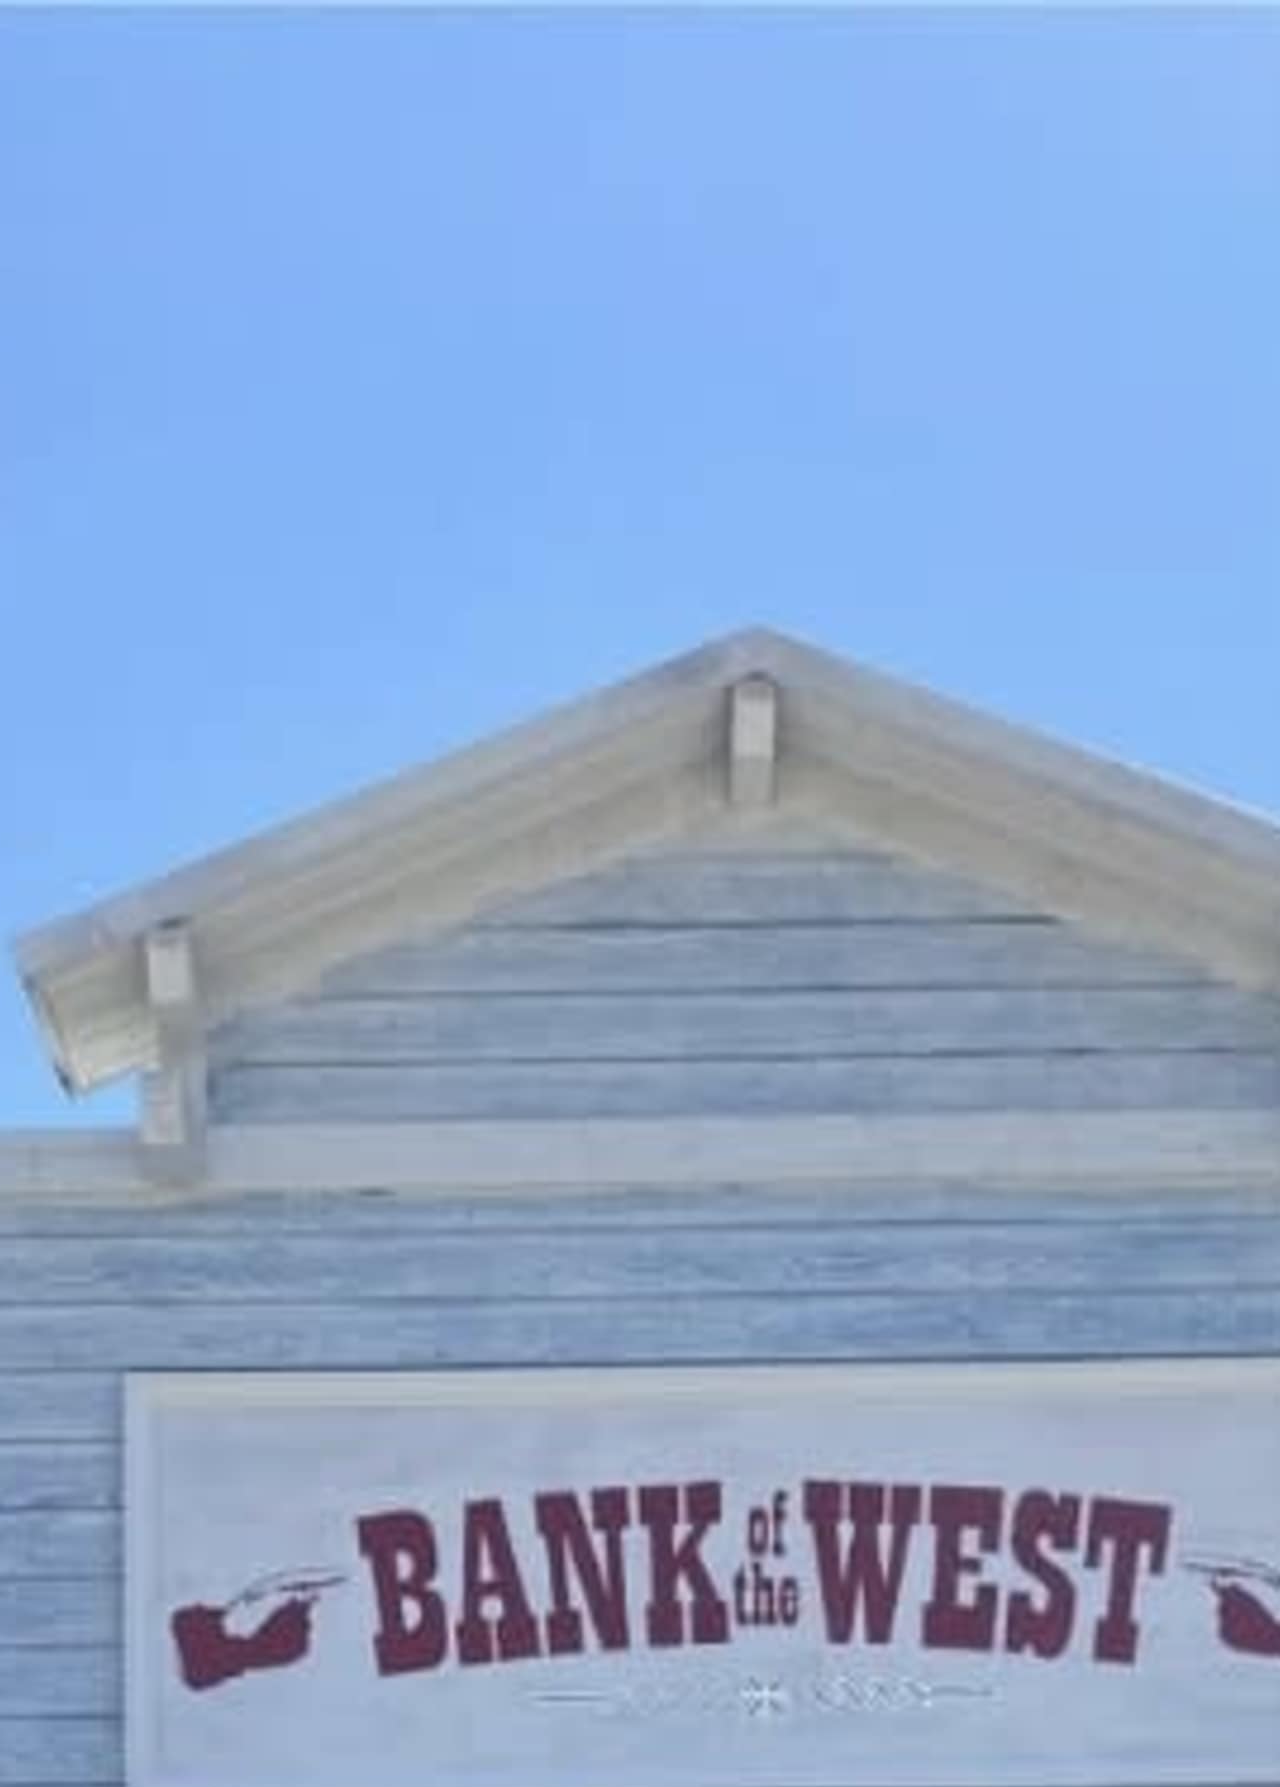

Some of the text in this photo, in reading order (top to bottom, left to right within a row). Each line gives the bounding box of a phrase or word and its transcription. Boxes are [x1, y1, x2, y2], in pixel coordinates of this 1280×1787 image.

[356, 1480, 1173, 1678] BANK of the WEST
